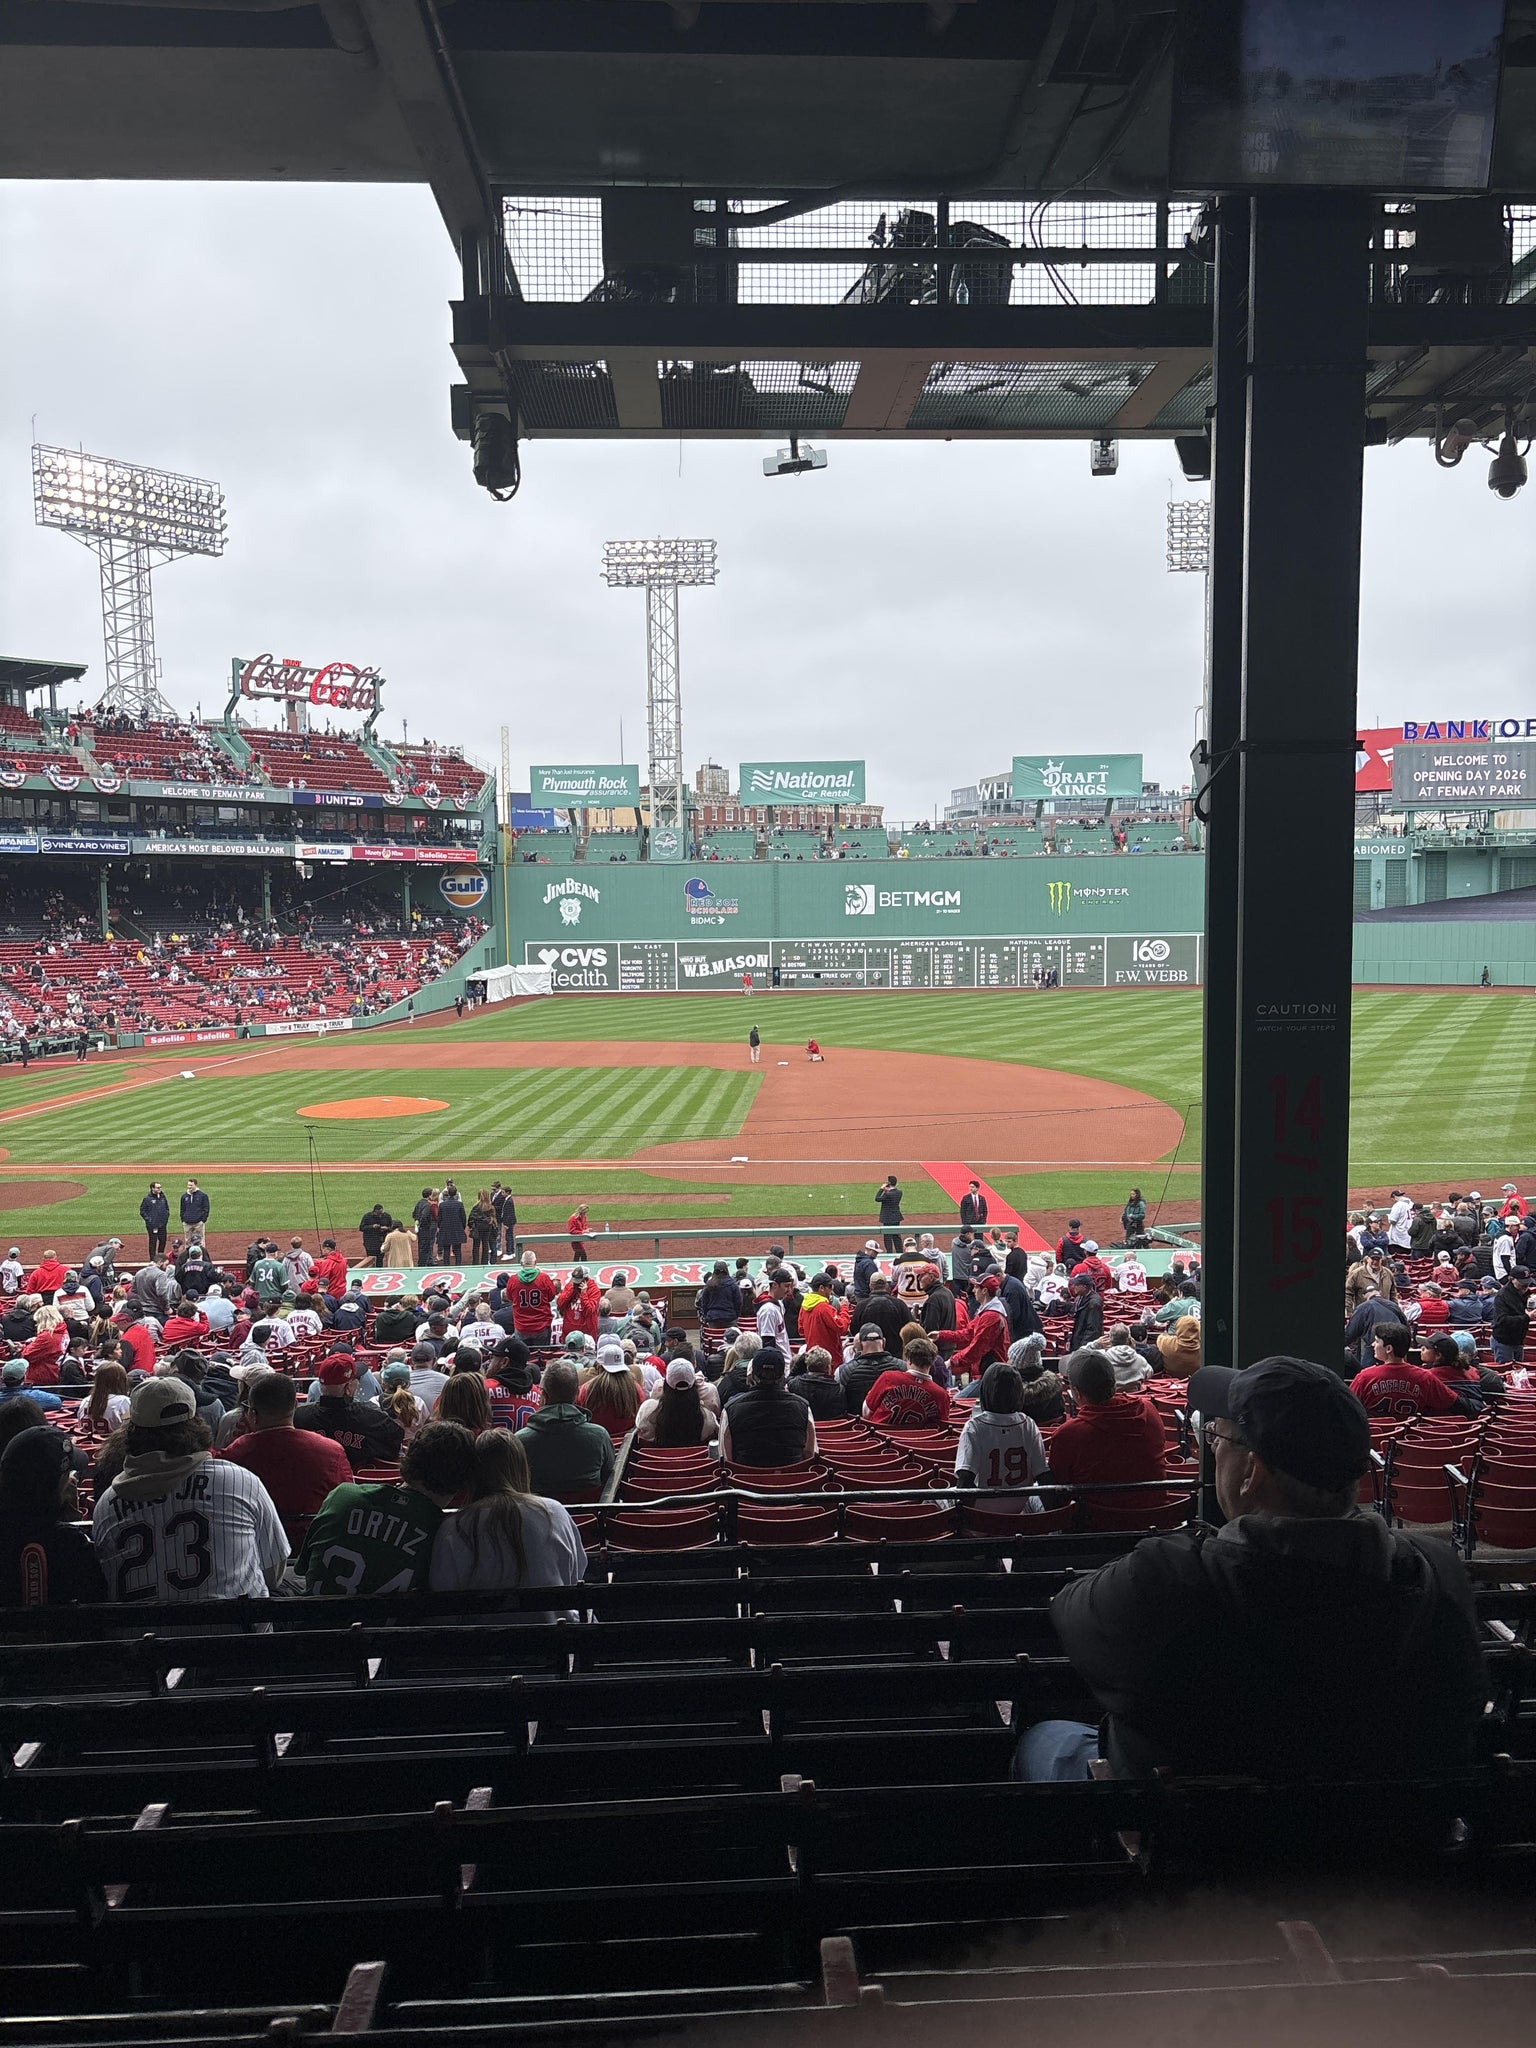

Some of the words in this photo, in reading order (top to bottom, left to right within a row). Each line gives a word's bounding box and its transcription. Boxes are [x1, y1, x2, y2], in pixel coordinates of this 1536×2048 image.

[1403, 720, 1488, 740] BANK
[1434, 754, 1488, 766] WELCOME
[1492, 754, 1507, 764] TO
[1043, 770, 1108, 787] DRAFT
[1414, 770, 1462, 782] OPENING
[1466, 770, 1490, 780] DAY
[1496, 770, 1526, 780] 2026
[542, 777, 595, 791] Plymouth
[599, 777, 627, 789] Rock
[1051, 784, 1107, 796] KINGS
[1418, 786, 1434, 796] AT
[1438, 786, 1486, 796] FENWAY
[1490, 785, 1521, 795] PARK
[162, 787, 199, 797] WELCOME
[201, 789, 210, 797] TO
[212, 789, 244, 799] FENWAY
[245, 791, 264, 800] PARK
[802, 790, 817, 798] Car
[820, 789, 850, 797] Rental
[146, 844, 187, 852] AMERICA'S
[189, 844, 209, 852] MOST
[212, 845, 245, 853] BELOVED
[247, 845, 284, 854] BALLPARK
[1354, 845, 1406, 854] ABIOMED
[441, 878, 484, 892] Gulf
[879, 891, 961, 906] BETMGM
[1074, 887, 1129, 897] MONSTER
[691, 917, 716, 925] BIDMC
[561, 948, 608, 967] CVS
[1115, 970, 1140, 982] F.W.
[1144, 970, 1188, 982] WEBB
[1256, 1004, 1336, 1015] CAUTION!
[150, 1034, 185, 1044] Safelite
[197, 1032, 230, 1040] Safelite
[1268, 1072, 1324, 1143] 14
[1264, 1196, 1323, 1264] 15
[258, 1268, 273, 1281] 34
[294, 1263, 300, 1275] 1
[1127, 1272, 1145, 1286] 34
[519, 1289, 541, 1308] 18
[488, 1387, 510, 1399] ABO
[1372, 1379, 1420, 1396] RAFAELA
[987, 1446, 1028, 1486] 19
[175, 1473, 212, 1501] JR.
[346, 1508, 428, 1557] ORTIZ
[113, 1507, 214, 1602] 23
